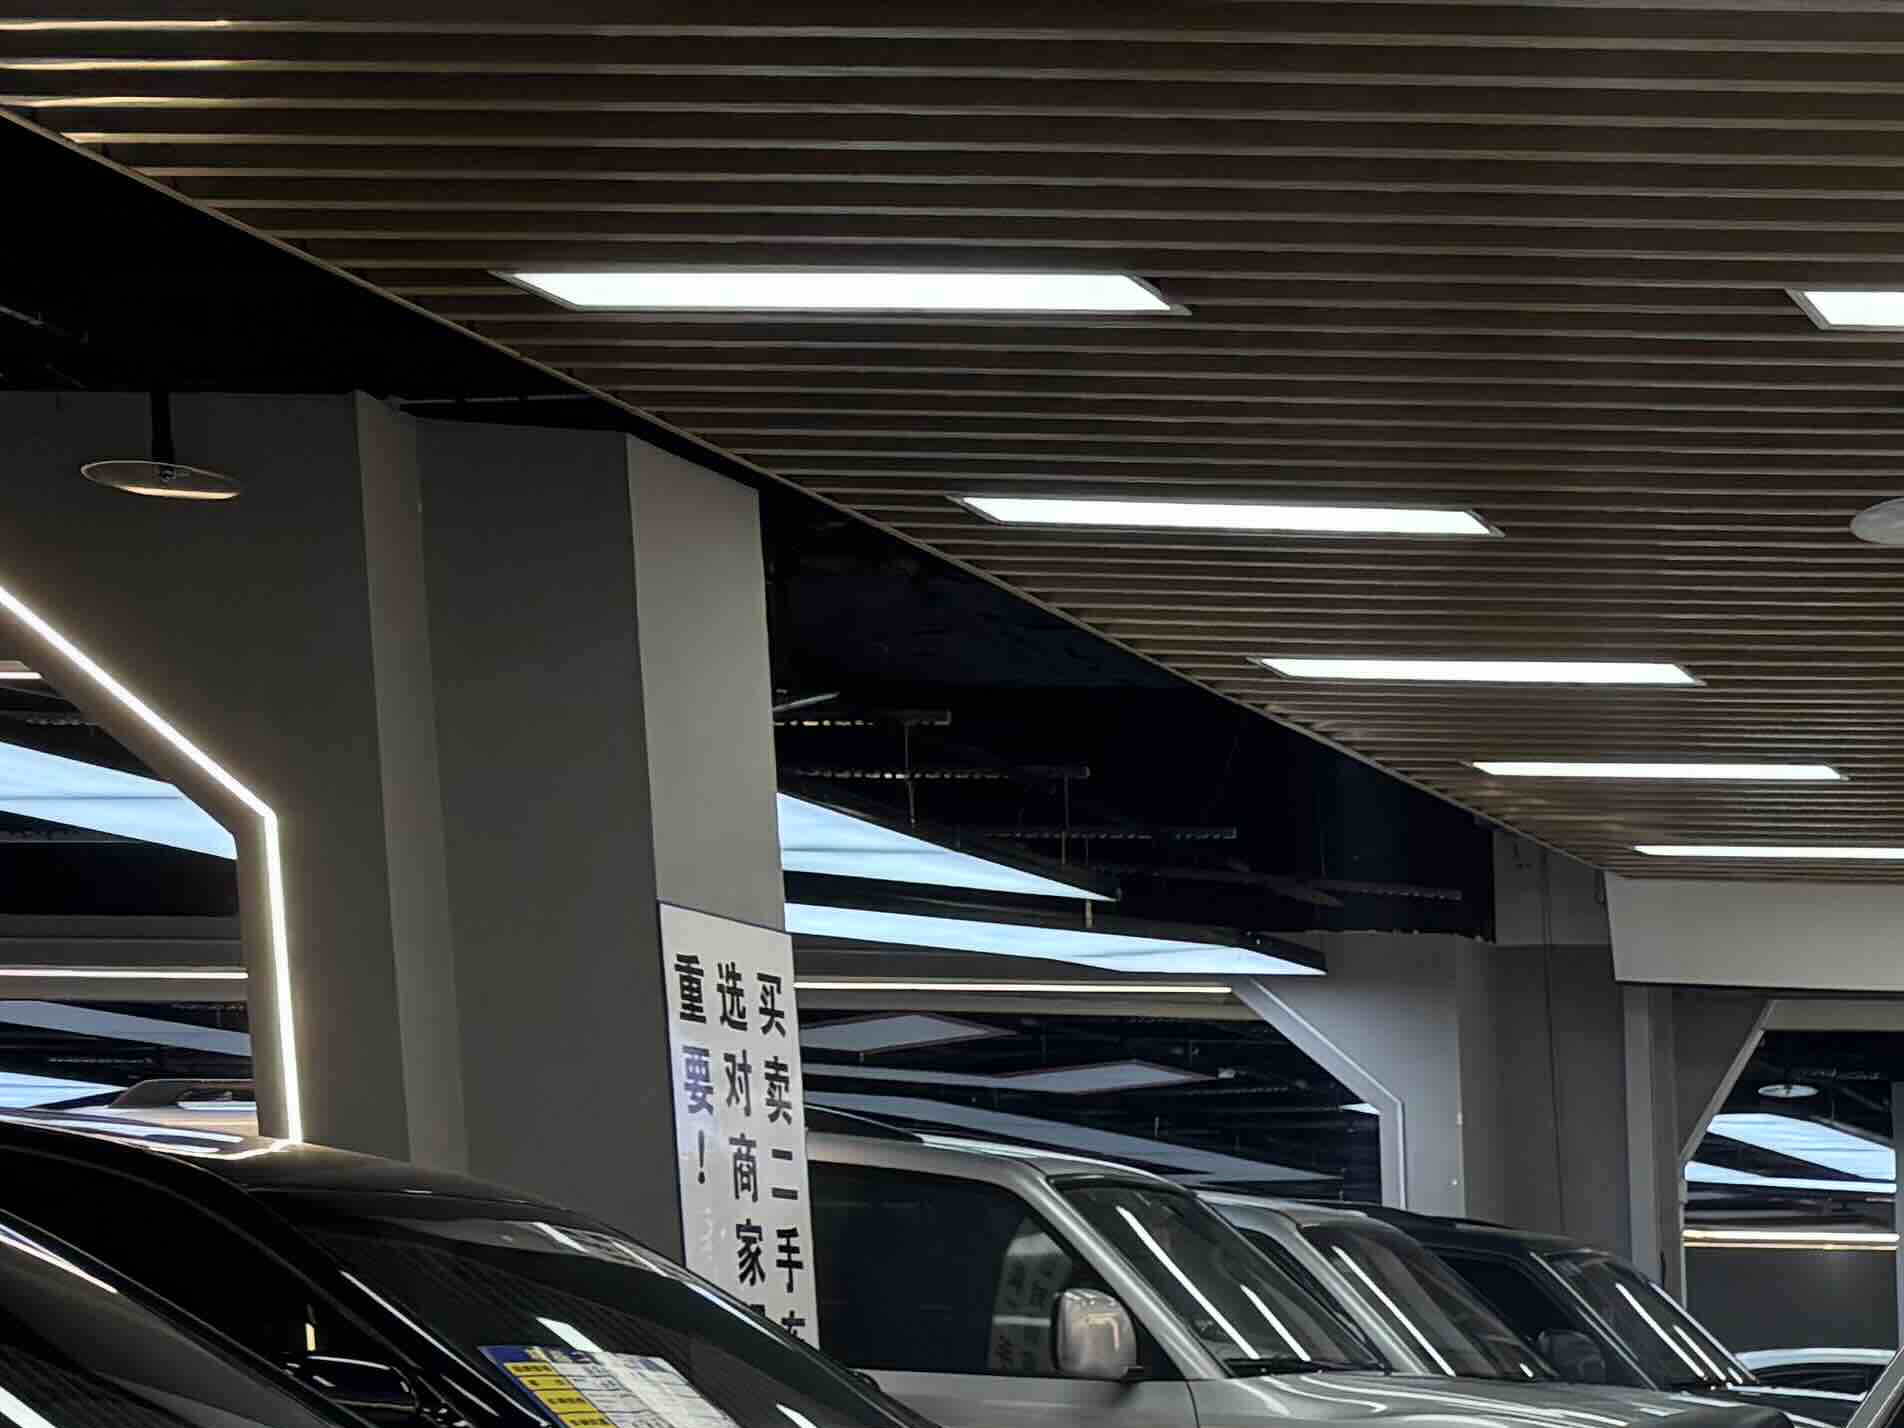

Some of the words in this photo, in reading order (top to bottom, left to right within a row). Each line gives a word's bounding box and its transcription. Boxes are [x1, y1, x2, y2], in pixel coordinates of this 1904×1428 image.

[673, 953, 715, 1185] 重要!
[716, 961, 767, 1317] 选对商家
